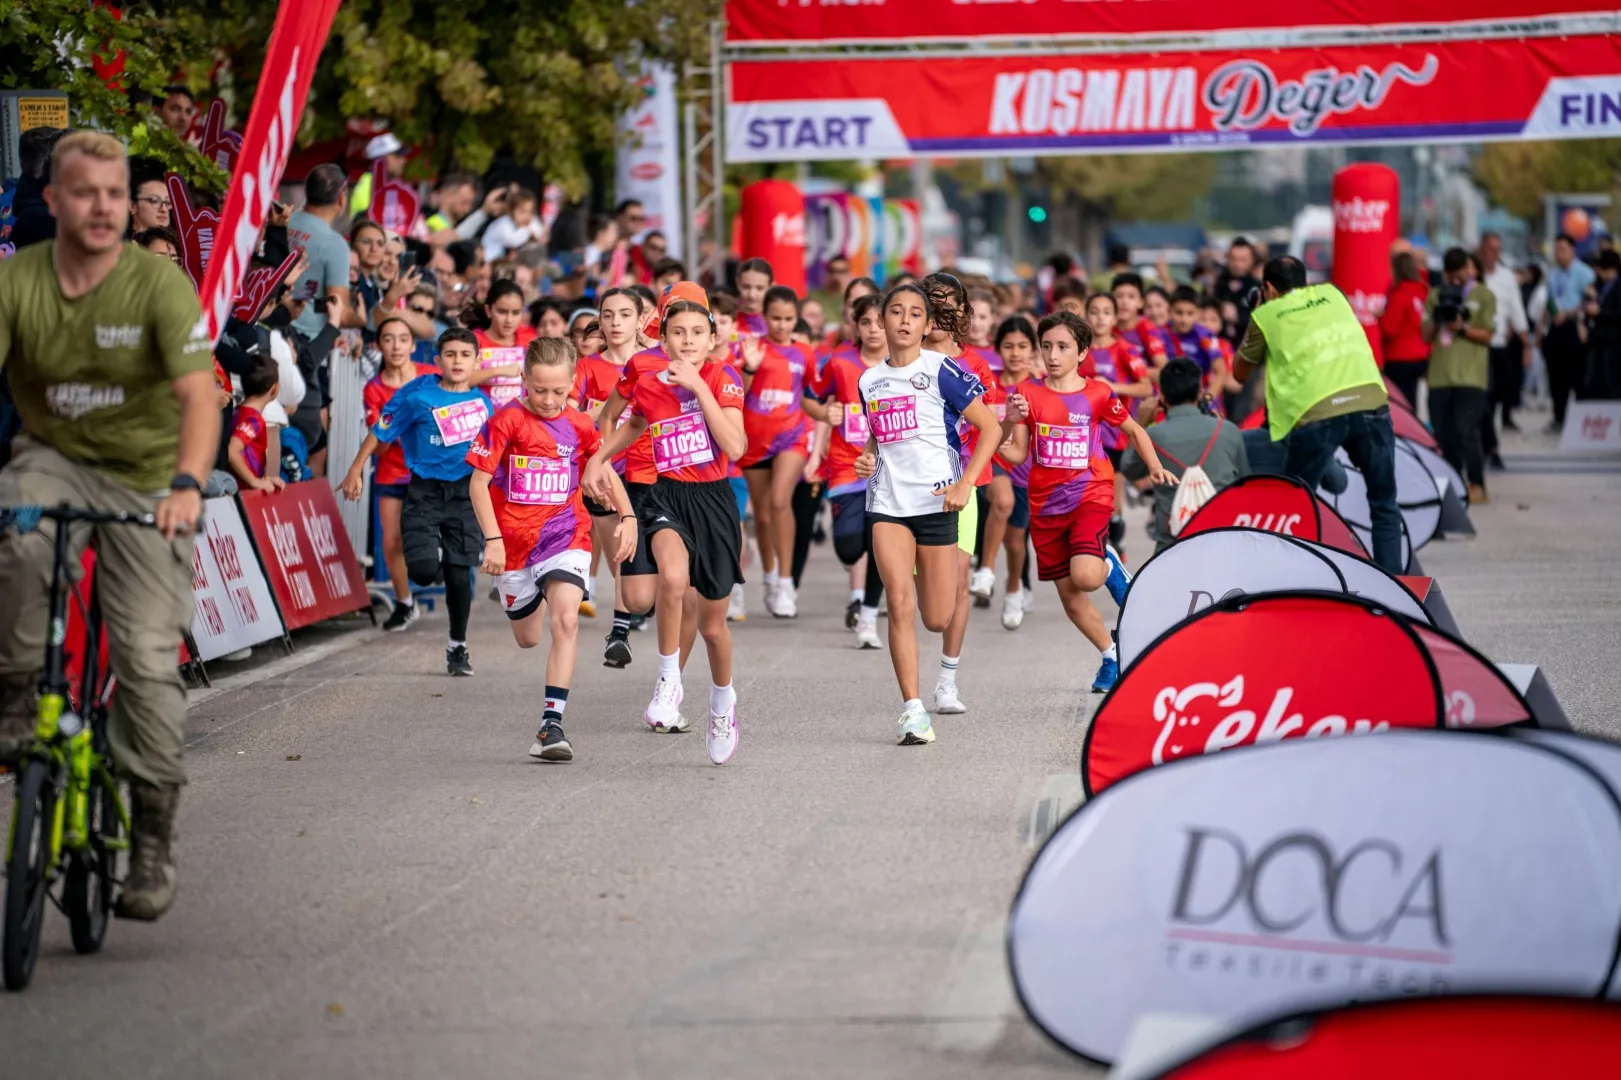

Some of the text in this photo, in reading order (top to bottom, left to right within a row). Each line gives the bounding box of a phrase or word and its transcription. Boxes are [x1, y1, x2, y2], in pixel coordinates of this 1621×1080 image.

[989, 53, 1440, 137] KOŞMAYA Değer
[1561, 94, 1621, 125] FIN
[747, 116, 873, 149] START
[879, 410, 917, 433] 11018
[661, 430, 708, 458] 11029
[1046, 440, 1088, 458] 11059
[524, 472, 569, 493] 11010
[1168, 825, 1455, 949] DOCA
